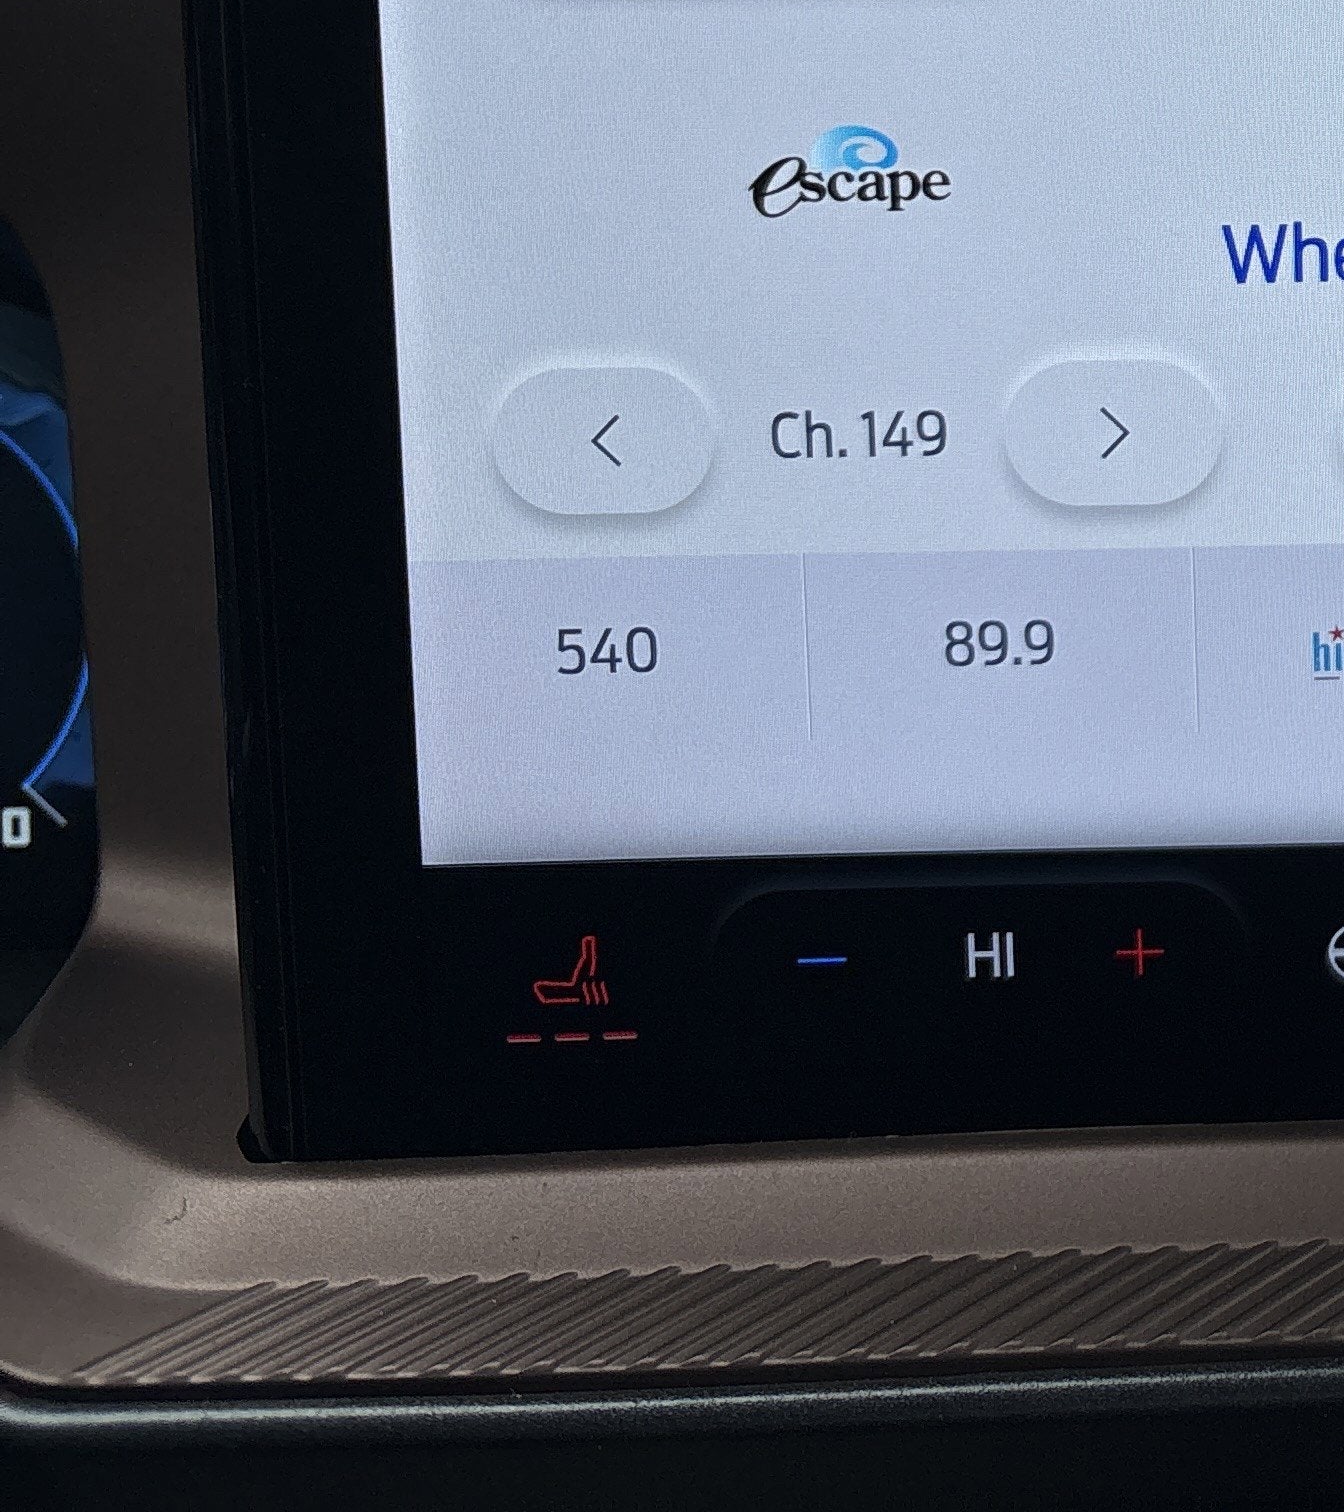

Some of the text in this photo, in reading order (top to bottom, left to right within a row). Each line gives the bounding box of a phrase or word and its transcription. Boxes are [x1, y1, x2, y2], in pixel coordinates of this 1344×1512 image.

[771, 409, 947, 459] Ch. 149
[557, 626, 658, 675] 540
[944, 619, 1054, 667] 89.9
[967, 931, 1015, 978] HI
